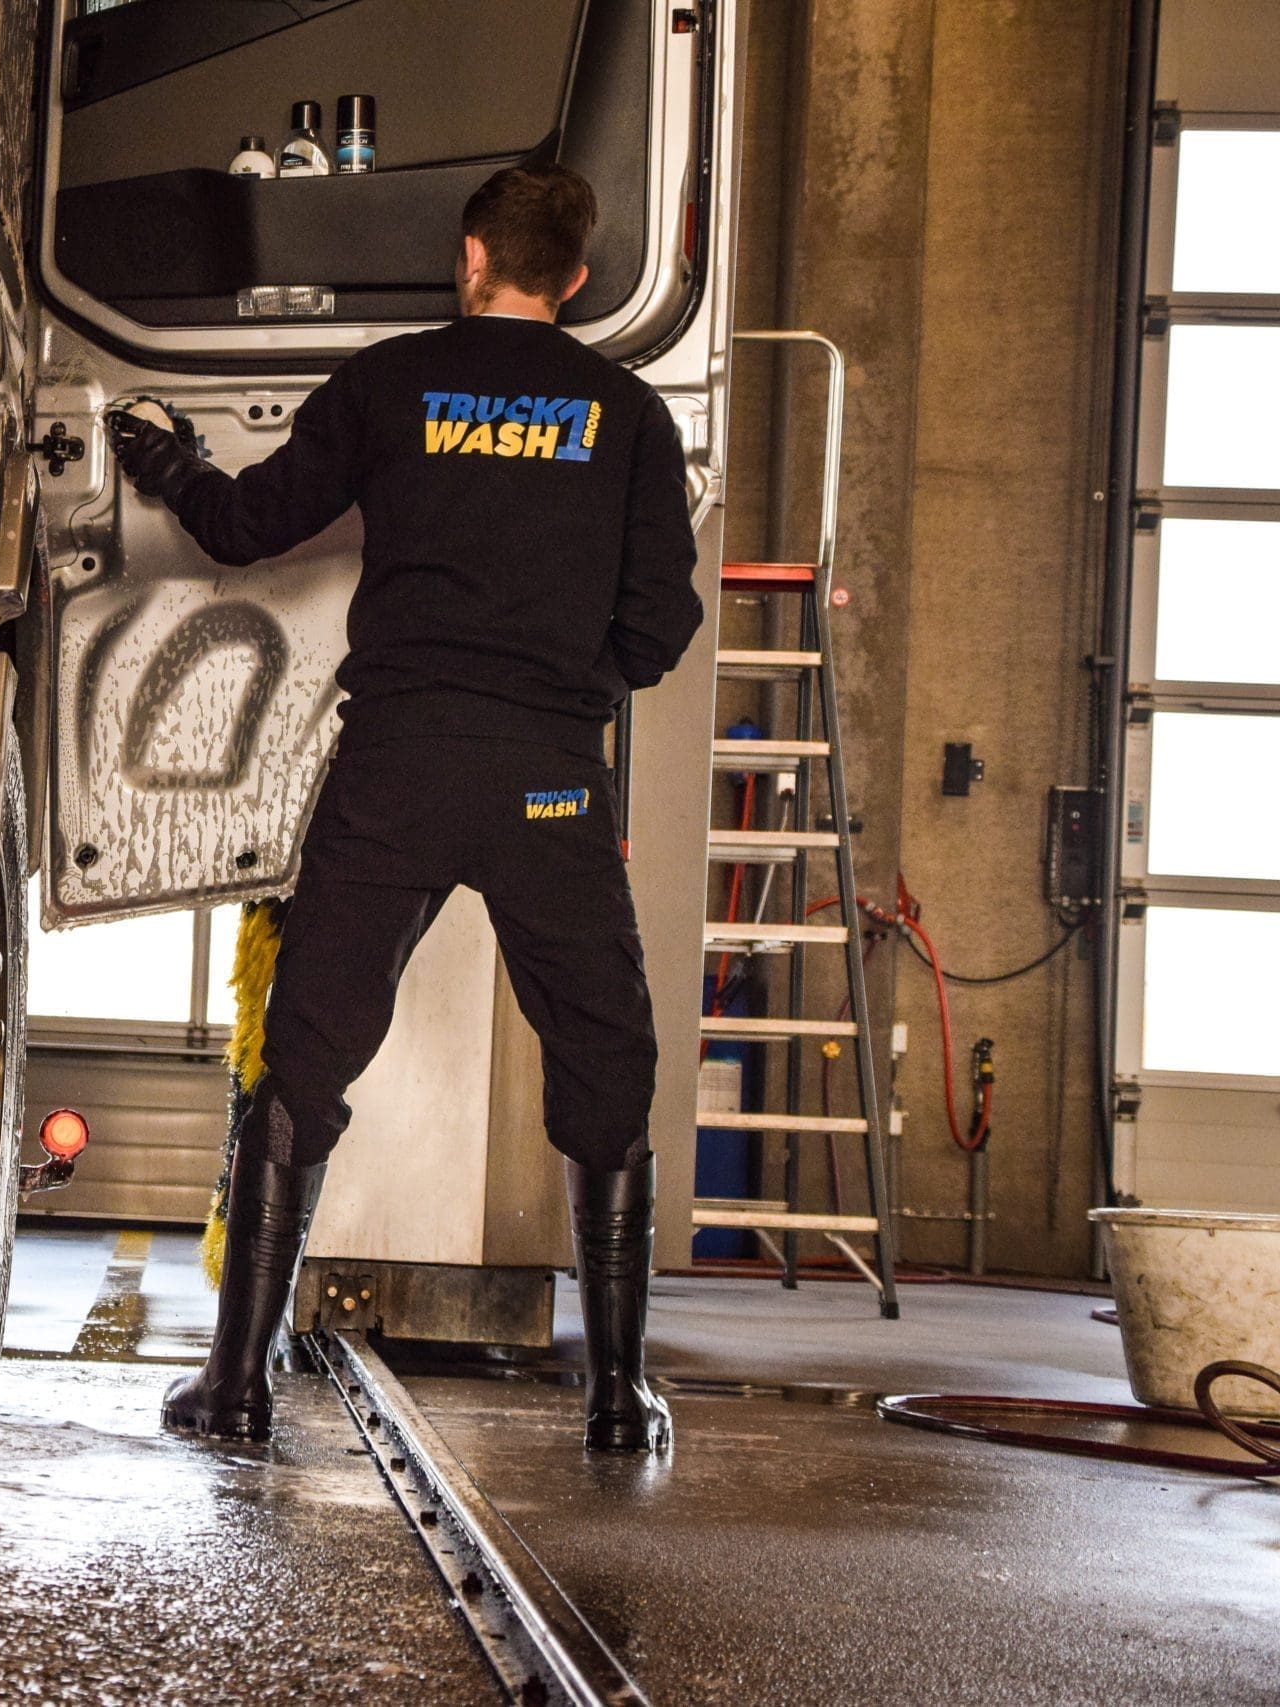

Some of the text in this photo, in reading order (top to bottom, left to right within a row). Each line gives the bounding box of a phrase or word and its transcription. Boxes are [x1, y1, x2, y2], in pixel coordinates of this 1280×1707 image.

[422, 392, 569, 426] TRUCK
[582, 401, 602, 448] GROUP
[426, 421, 560, 458] WASH
[525, 790, 579, 805] TRUCK
[526, 801, 577, 819] WASH
